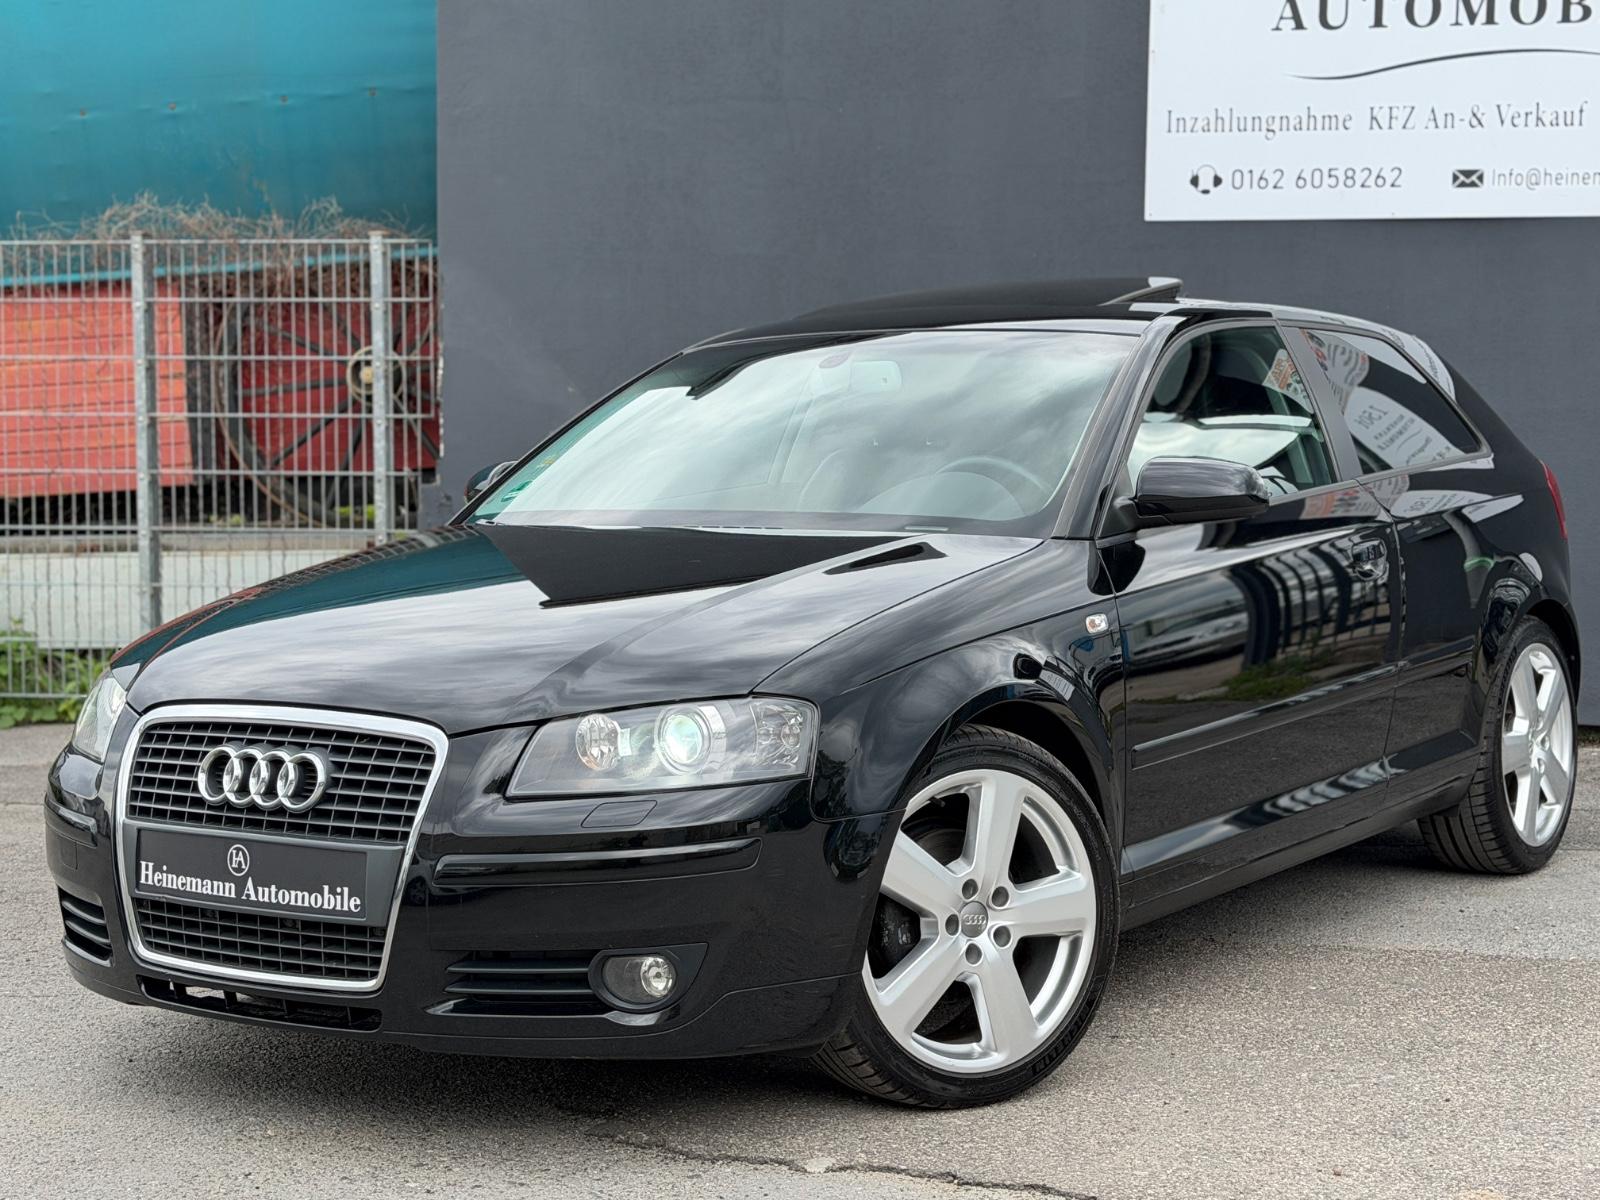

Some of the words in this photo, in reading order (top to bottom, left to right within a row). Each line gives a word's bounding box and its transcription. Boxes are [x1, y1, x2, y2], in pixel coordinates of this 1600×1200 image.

[1166, 106, 1352, 141] Inzahlungnahme
[1368, 106, 1415, 131] KFZ
[1424, 105, 1485, 130] An-&
[1496, 101, 1588, 129] Verkauf
[1231, 168, 1285, 191] 0162
[1295, 166, 1403, 190] 6058262
[139, 860, 237, 899] Heinemann
[241, 876, 362, 913] Automobile
